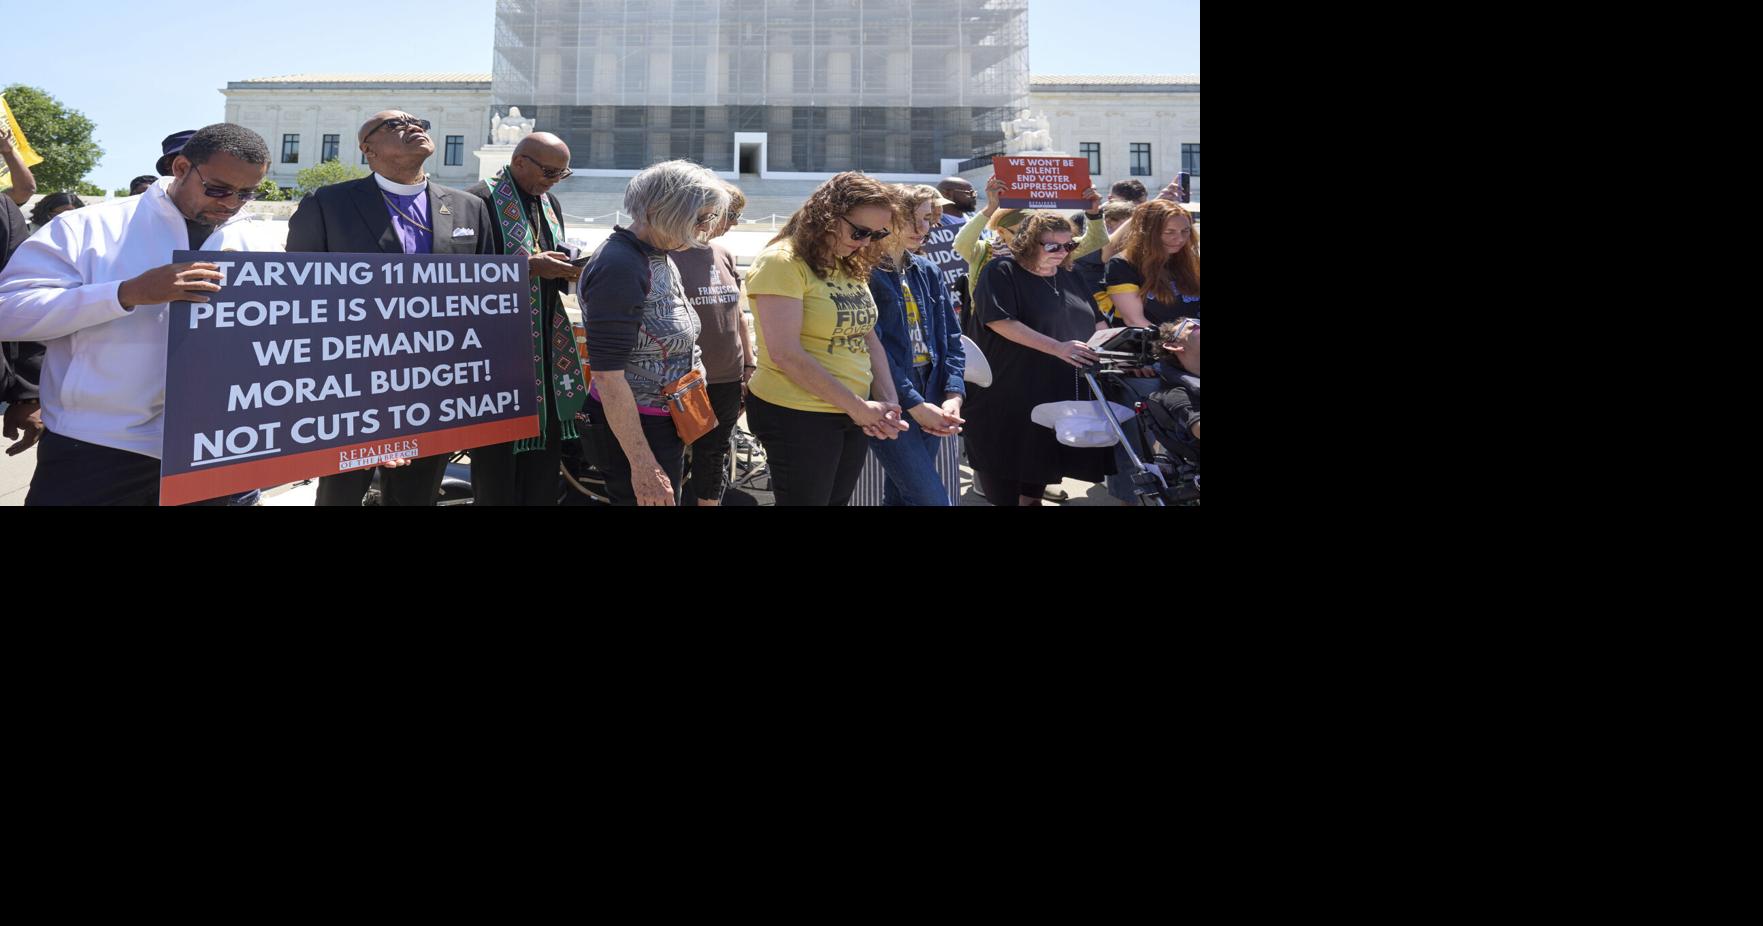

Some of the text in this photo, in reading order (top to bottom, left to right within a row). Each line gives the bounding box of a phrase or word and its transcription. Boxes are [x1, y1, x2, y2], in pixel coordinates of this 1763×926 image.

[1008, 158, 1075, 167] WE WON'T BE
[1025, 166, 1060, 175] SILENT!
[1011, 182, 1077, 191] SUPPRESSION
[1017, 174, 1070, 183] END VOTER
[1030, 190, 1058, 199] NOW!
[216, 261, 520, 287] TARVING 11 MILLION
[189, 293, 519, 329] PEOPLE IS VIOLENCE!
[836, 308, 876, 328] FIGH
[252, 328, 482, 366] WE DEMAND A
[227, 359, 491, 412] MORAL BUDGET!
[193, 389, 520, 462] NOT CUTS TO SNAP!
[339, 439, 418, 461] REPAIRERS
[340, 460, 353, 469] OF
[384, 448, 417, 461] BREACH
